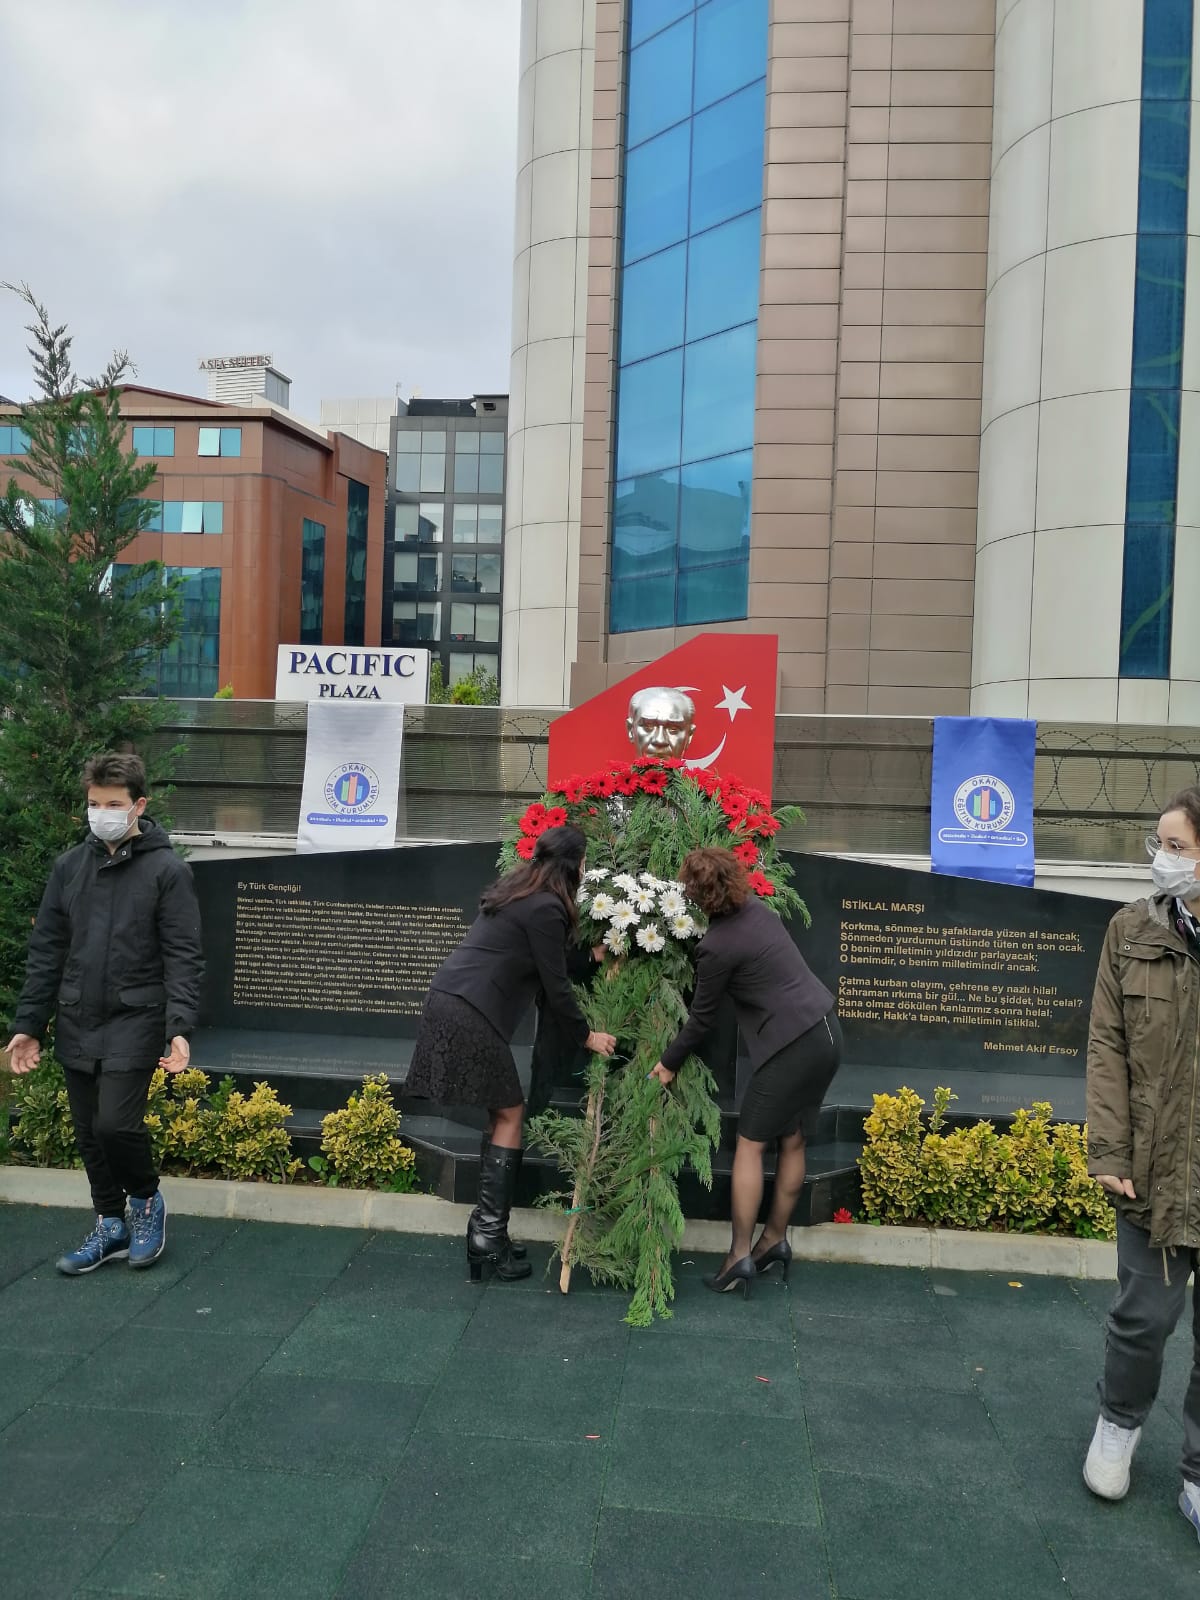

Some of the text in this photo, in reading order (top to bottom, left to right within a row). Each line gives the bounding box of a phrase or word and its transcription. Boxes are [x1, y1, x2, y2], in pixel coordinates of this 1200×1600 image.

[289, 651, 415, 677] PACIFIC
[319, 683, 381, 699] PLAZA
[342, 765, 366, 773] OKAN
[972, 778, 998, 787] OKAN
[237, 881, 247, 891] Ey
[249, 882, 266, 890] Türk
[843, 898, 925, 915] İSTİKLAL MARŞI
[841, 921, 881, 934] Korkma,
[885, 923, 923, 934] sönmez
[926, 925, 938, 935] bu
[996, 929, 1026, 941] yüzen
[1029, 930, 1037, 940] al
[1040, 931, 1080, 944] sancak;
[840, 932, 1086, 953] Sönmeden yurdumun üstünde tüten en son ocak.
[840, 942, 848, 952] O
[851, 943, 881, 953] benim
[840, 953, 847, 963] O
[899, 958, 905, 966] o
[908, 957, 938, 967] benim
[1007, 962, 1040, 972] ancak.
[839, 976, 1057, 996] Çatma kurban olayım, çehrene ey nazlı hilal!
[839, 987, 1082, 1008] Kahraman ırkıma bir gül... Ne bu şiddet, bu celal?
[838, 998, 862, 1008] Sana
[865, 999, 895, 1010] olmaz
[897, 1001, 937, 1012] dökülen
[993, 1008, 1022, 1016] sonra
[1025, 1007, 1052, 1020] helal;
[883, 1011, 916, 1021] Hakk'a
[919, 1012, 949, 1025] tapan,
[984, 1040, 1078, 1056] Mehmet Akif Ersoy
